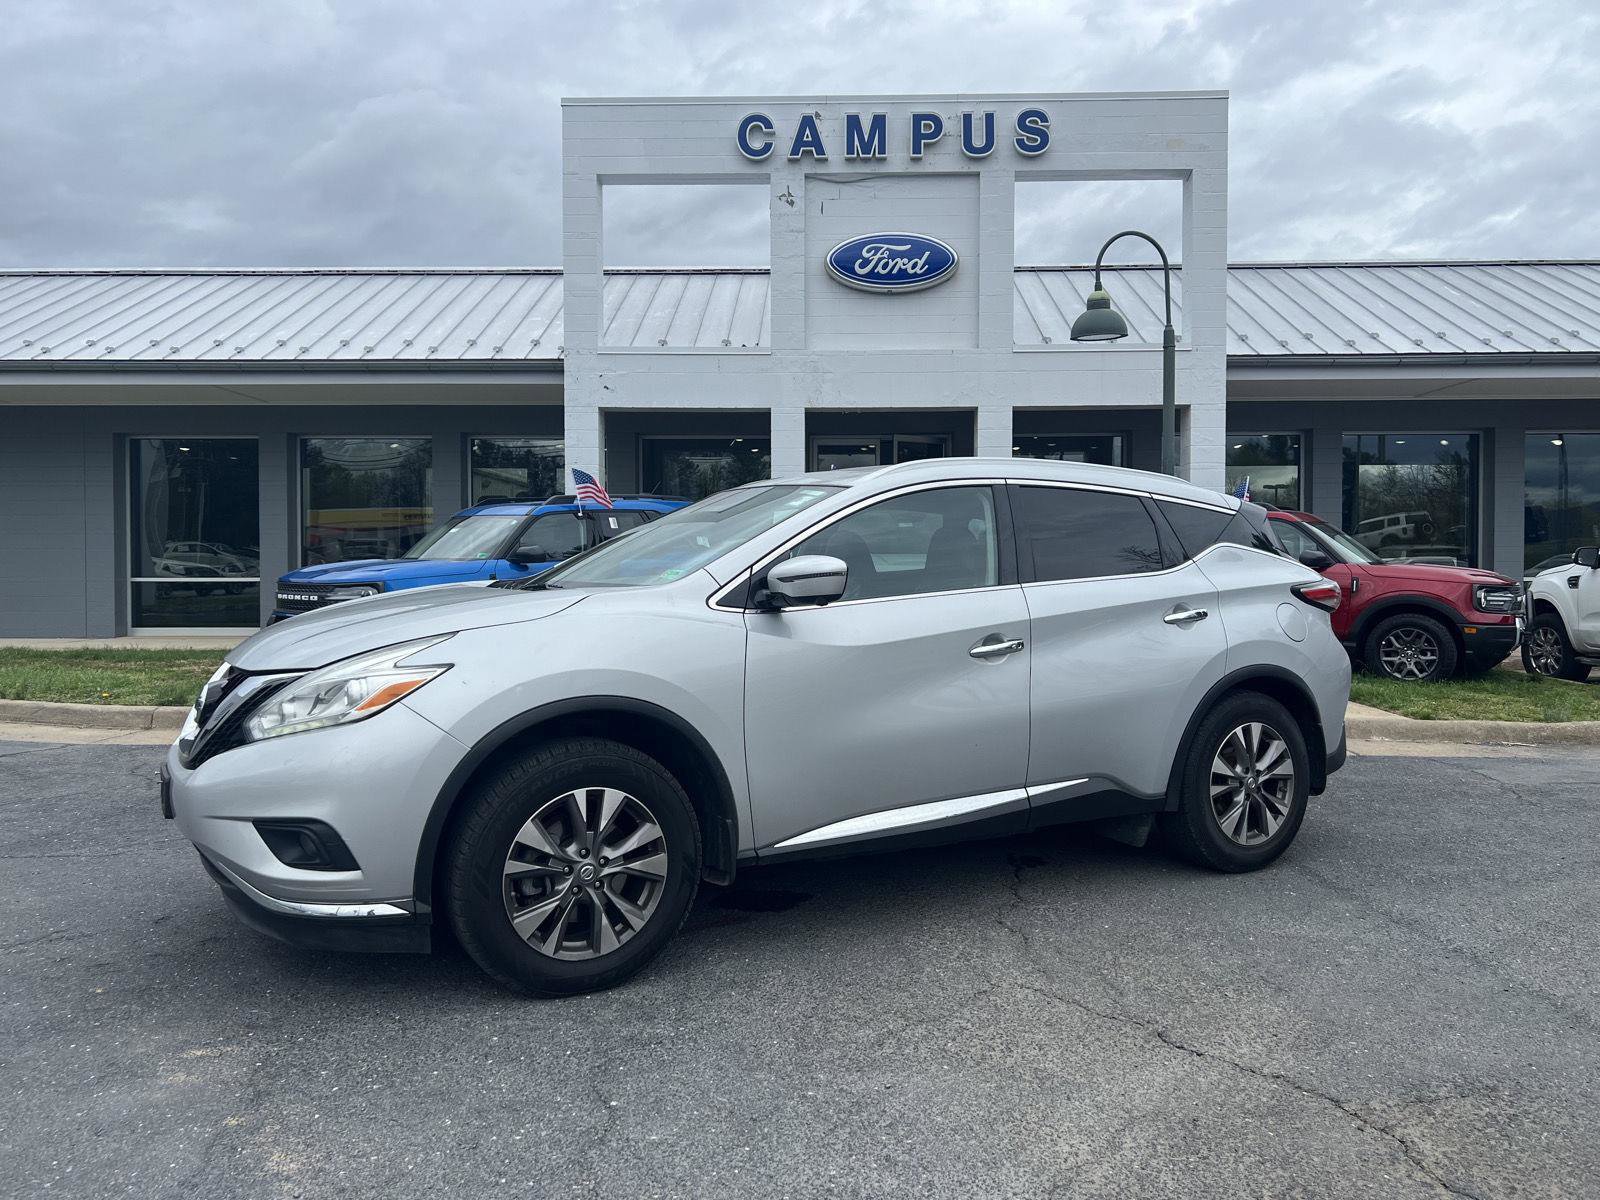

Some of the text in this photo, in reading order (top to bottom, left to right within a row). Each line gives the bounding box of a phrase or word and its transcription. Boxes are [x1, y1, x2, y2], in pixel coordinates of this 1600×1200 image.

[737, 108, 1050, 160] CAMPUS
[854, 243, 931, 275] Ford
[277, 593, 318, 601] BRONCO
